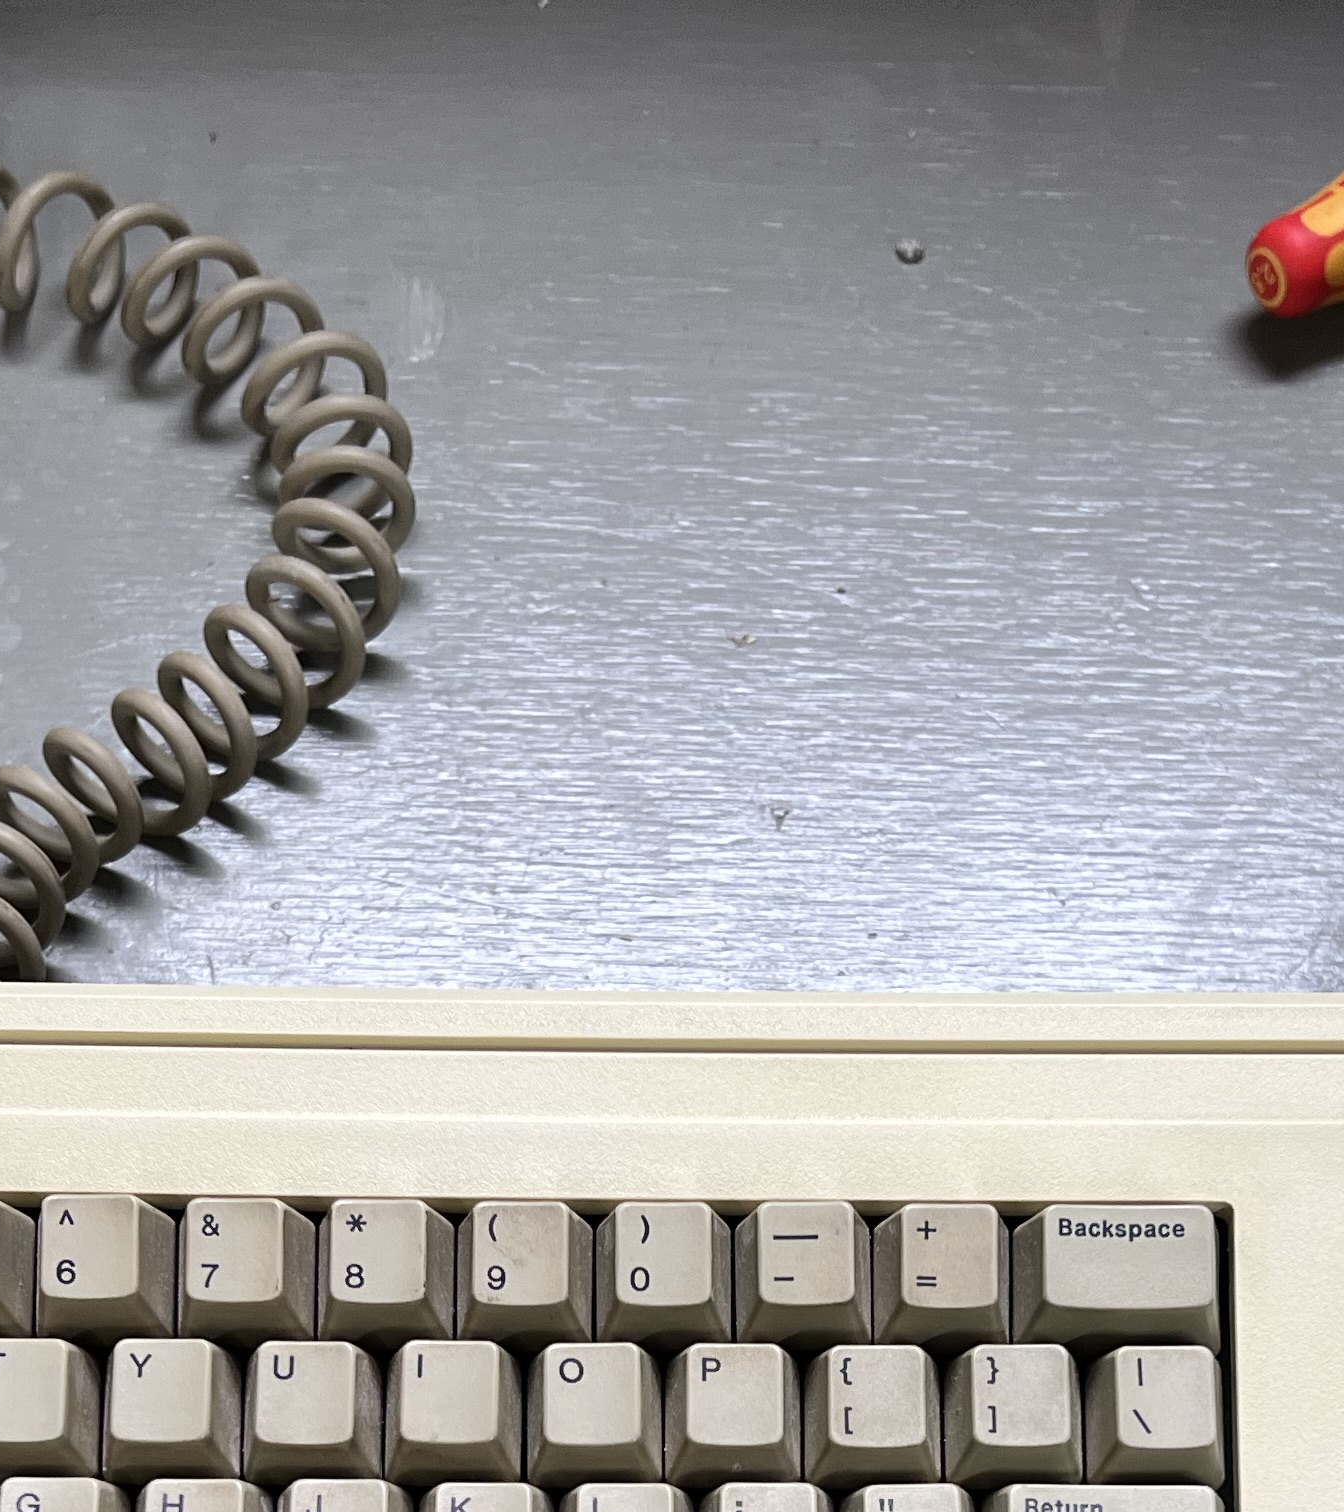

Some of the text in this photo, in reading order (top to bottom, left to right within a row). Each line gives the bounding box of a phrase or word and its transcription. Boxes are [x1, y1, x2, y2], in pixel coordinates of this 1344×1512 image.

[1058, 1217, 1185, 1243] Backspace
[56, 1259, 76, 1285] 6
[201, 1263, 220, 1289] 7
[344, 1263, 365, 1289] 8
[487, 1265, 506, 1291] 9
[630, 1266, 650, 1292] 0
[129, 1353, 152, 1379] Y
[273, 1354, 295, 1381] U
[417, 1353, 424, 1379] I
[558, 1357, 584, 1384] O
[701, 1356, 722, 1382] P
